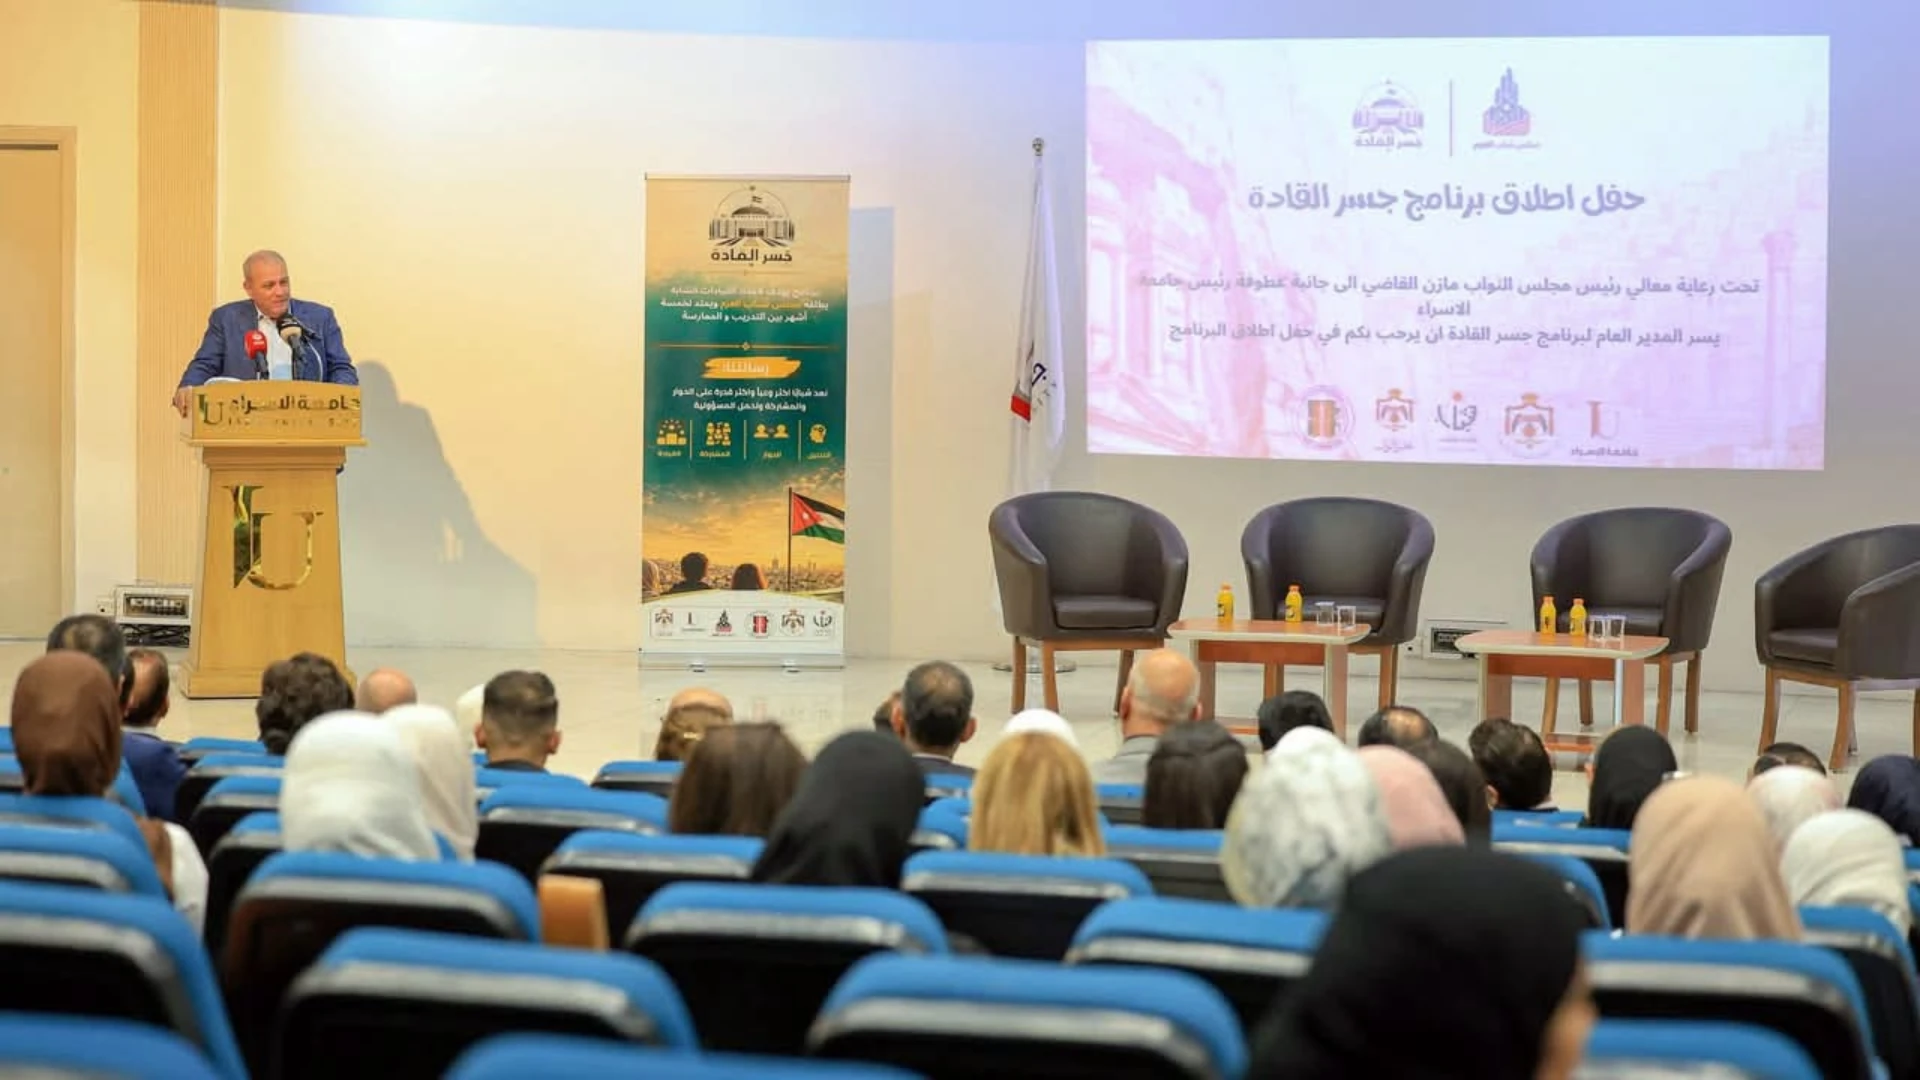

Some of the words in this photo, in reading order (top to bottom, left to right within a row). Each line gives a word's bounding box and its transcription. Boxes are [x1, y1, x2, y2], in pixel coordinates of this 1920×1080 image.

[1248, 182, 1330, 212] القادة
[1334, 185, 1399, 218] جسر
[1403, 183, 1485, 221] برنامج
[1492, 183, 1574, 216] اطلاق
[1581, 184, 1646, 217] حفل
[1188, 270, 1231, 291] رئيس
[1361, 275, 1418, 297] القاضي
[1422, 276, 1459, 294] مازن
[1463, 275, 1513, 295] النواب
[1517, 277, 1572, 296] مجلس
[1575, 275, 1622, 296] رئيس
[1626, 276, 1672, 300] معالي
[1675, 277, 1716, 296] رعاية
[1719, 279, 1760, 294] تحت
[731, 311, 766, 322] التدريب
[1168, 322, 1227, 342] البرنامج
[1231, 323, 1275, 340] اطلاق
[1280, 324, 1312, 341] حفل
[1317, 324, 1341, 345] في
[1345, 325, 1371, 344] بكم
[1376, 327, 1421, 344] يرحب
[1450, 325, 1491, 342] القادة
[1495, 328, 1533, 345] جسر
[1537, 327, 1592, 348] لبرنامج
[1597, 328, 1632, 348] العام
[1636, 328, 1682, 347] المدير
[1687, 333, 1720, 348] يسر
